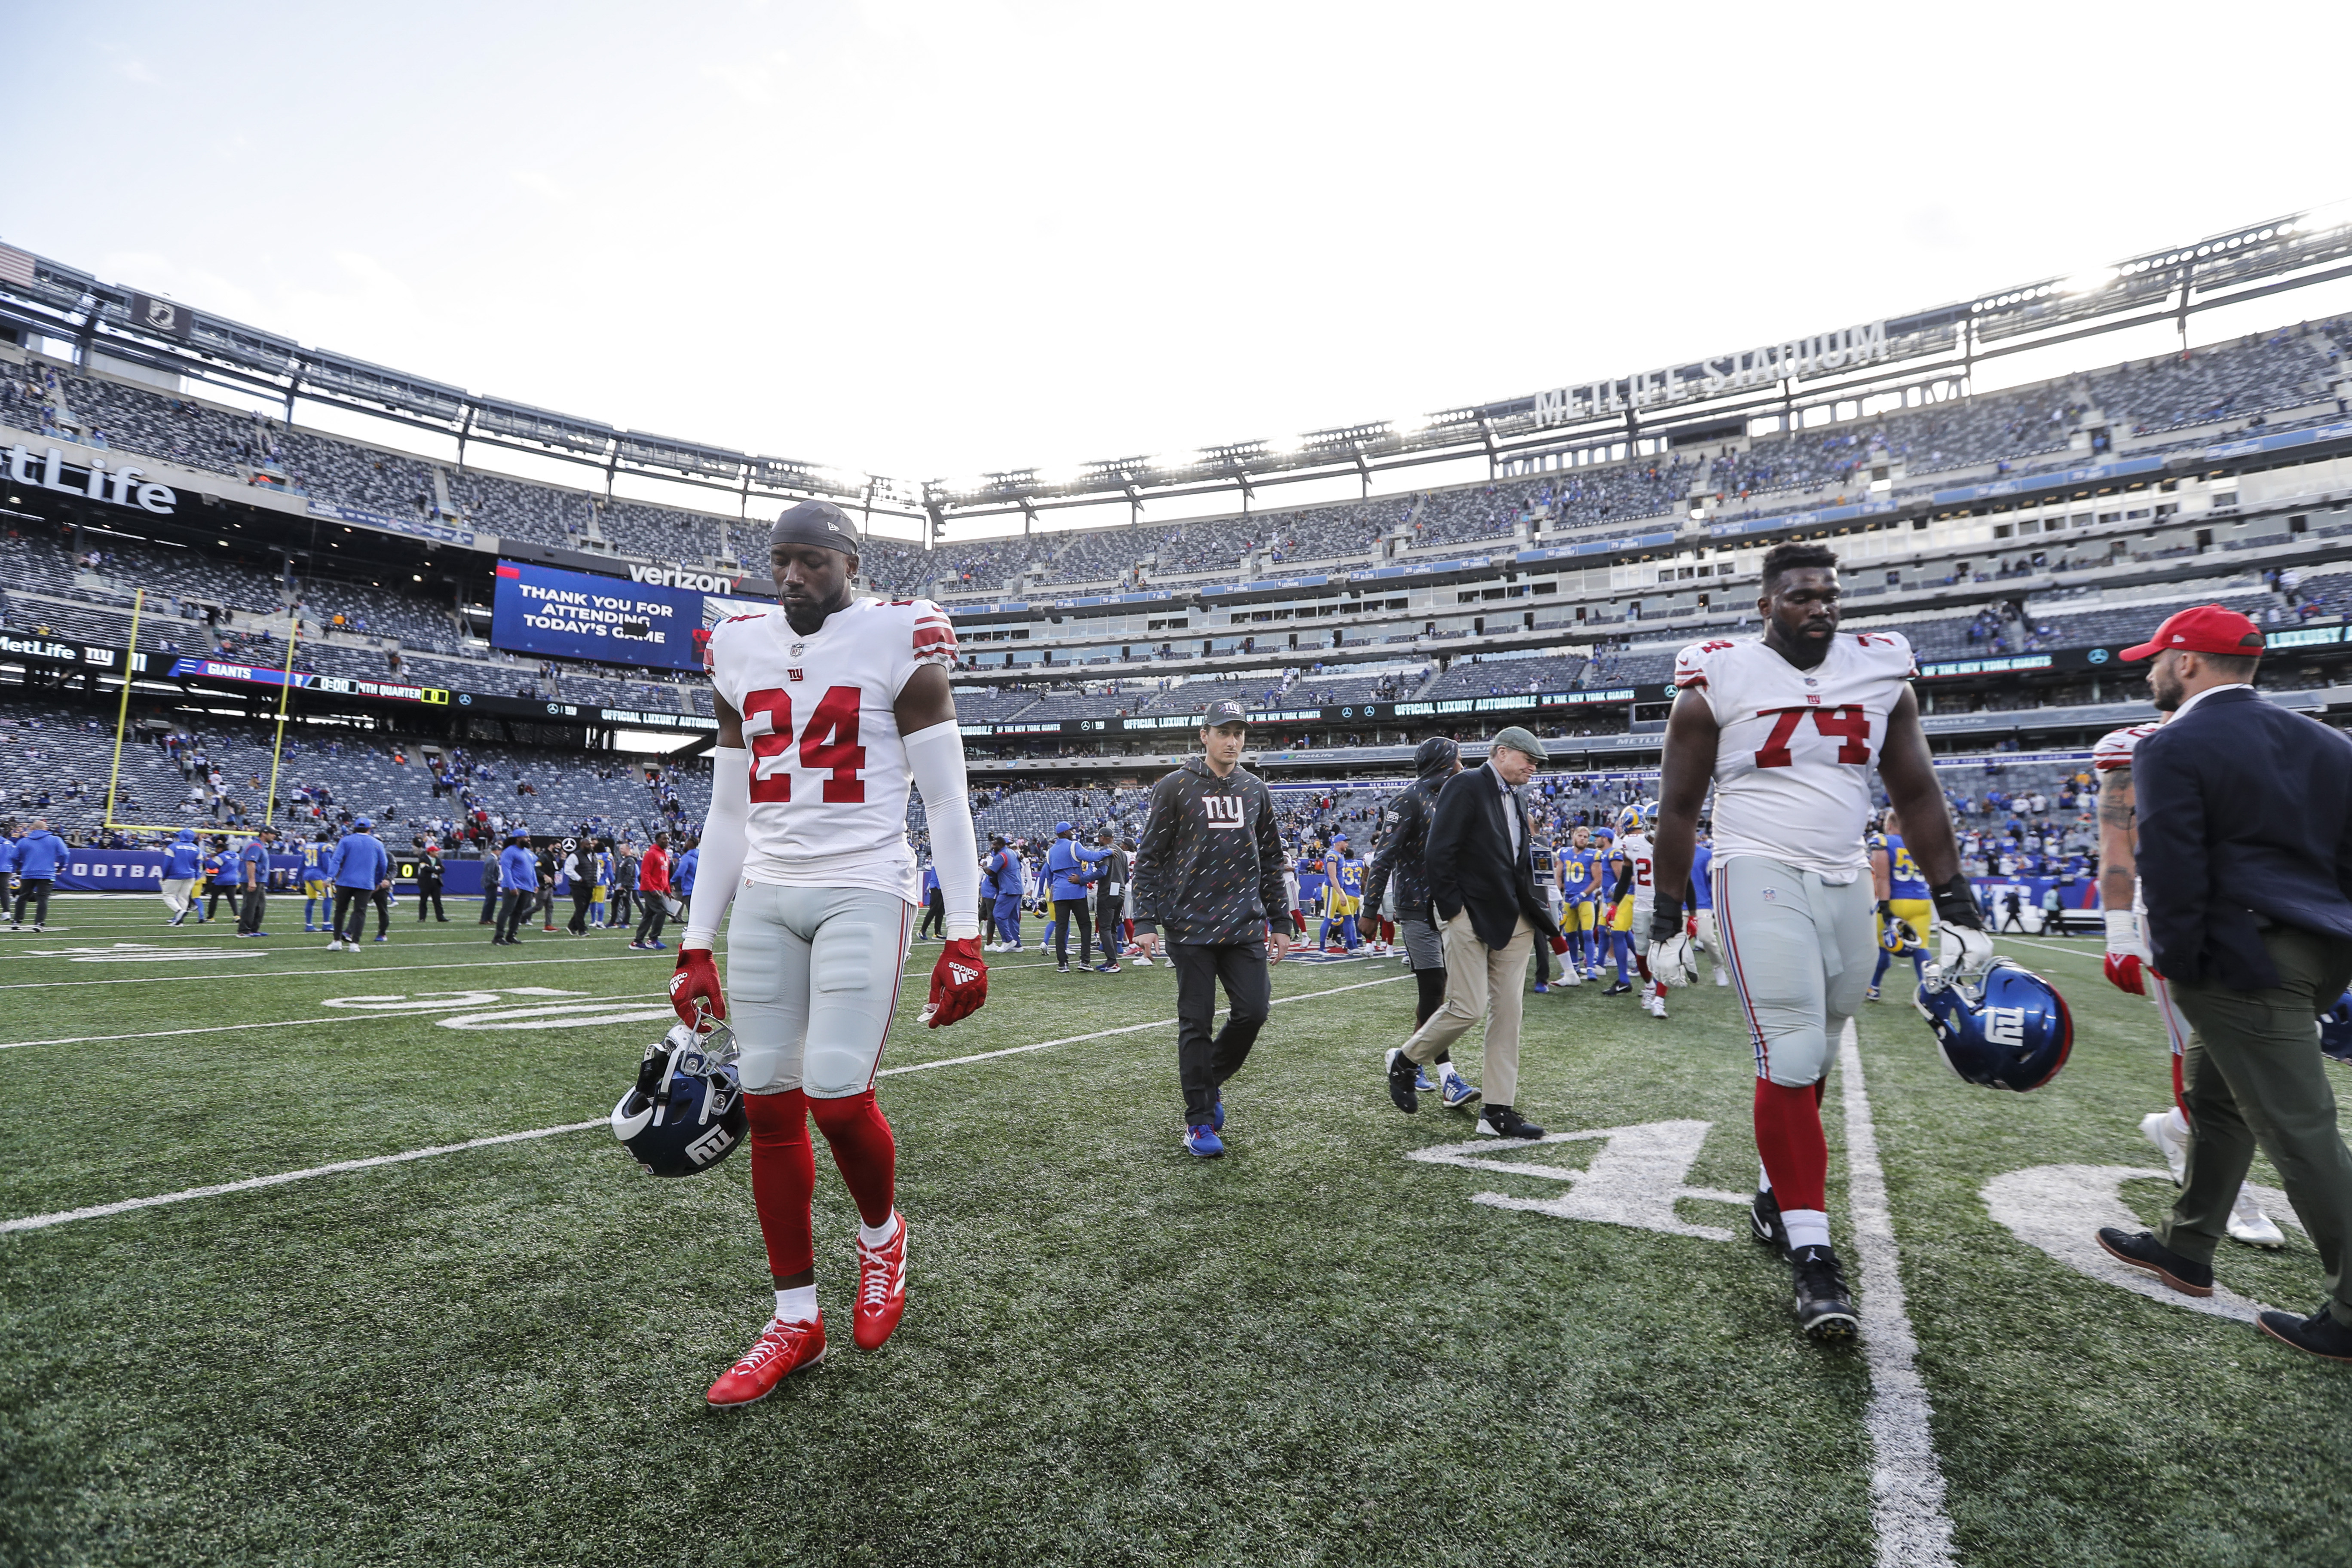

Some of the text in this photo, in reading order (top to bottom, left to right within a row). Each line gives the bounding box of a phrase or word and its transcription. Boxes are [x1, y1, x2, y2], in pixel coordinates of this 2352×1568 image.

[1534, 364, 1687, 427] METLIFE
[1703, 321, 1887, 392] STADIUM
[0, 443, 177, 514] tLife
[628, 564, 731, 595] verizon
[519, 584, 673, 618] THANK YOU FOR
[541, 603, 651, 628] ATTENDING
[207, 662, 252, 680] GIANTS
[1921, 665, 1937, 677] OF
[1937, 663, 1958, 676] THE
[1981, 658, 2010, 672] YORK
[2010, 655, 2052, 669] GIANTS
[320, 677, 350, 692] 0:00
[358, 682, 422, 700] 4TH QUARTER
[430, 689, 440, 701] 0
[1395, 689, 1635, 716] OFFICIAL LUXURY AUTOMOBILE OF THE NEW YORK GIANTS
[601, 708, 642, 723] OFFICIAL
[643, 712, 678, 726] LUXURY
[1041, 723, 1061, 732] GIANTS
[1123, 717, 1158, 730] OFFICIAL
[1159, 716, 1190, 728] LUXURY
[1246, 714, 1255, 722] OF
[1255, 714, 1267, 722] THE
[1268, 713, 1281, 721] NEW
[1281, 711, 1298, 720] YORK
[1298, 710, 1321, 719] GIANTS
[743, 686, 866, 803] 24
[1755, 704, 1871, 769] 74
[1202, 795, 1245, 829] ny
[304, 849, 318, 867] 31
[401, 864, 413, 878] 0
[1344, 867, 1363, 885] 33
[1565, 860, 1585, 883] 10
[949, 962, 979, 977] adidas
